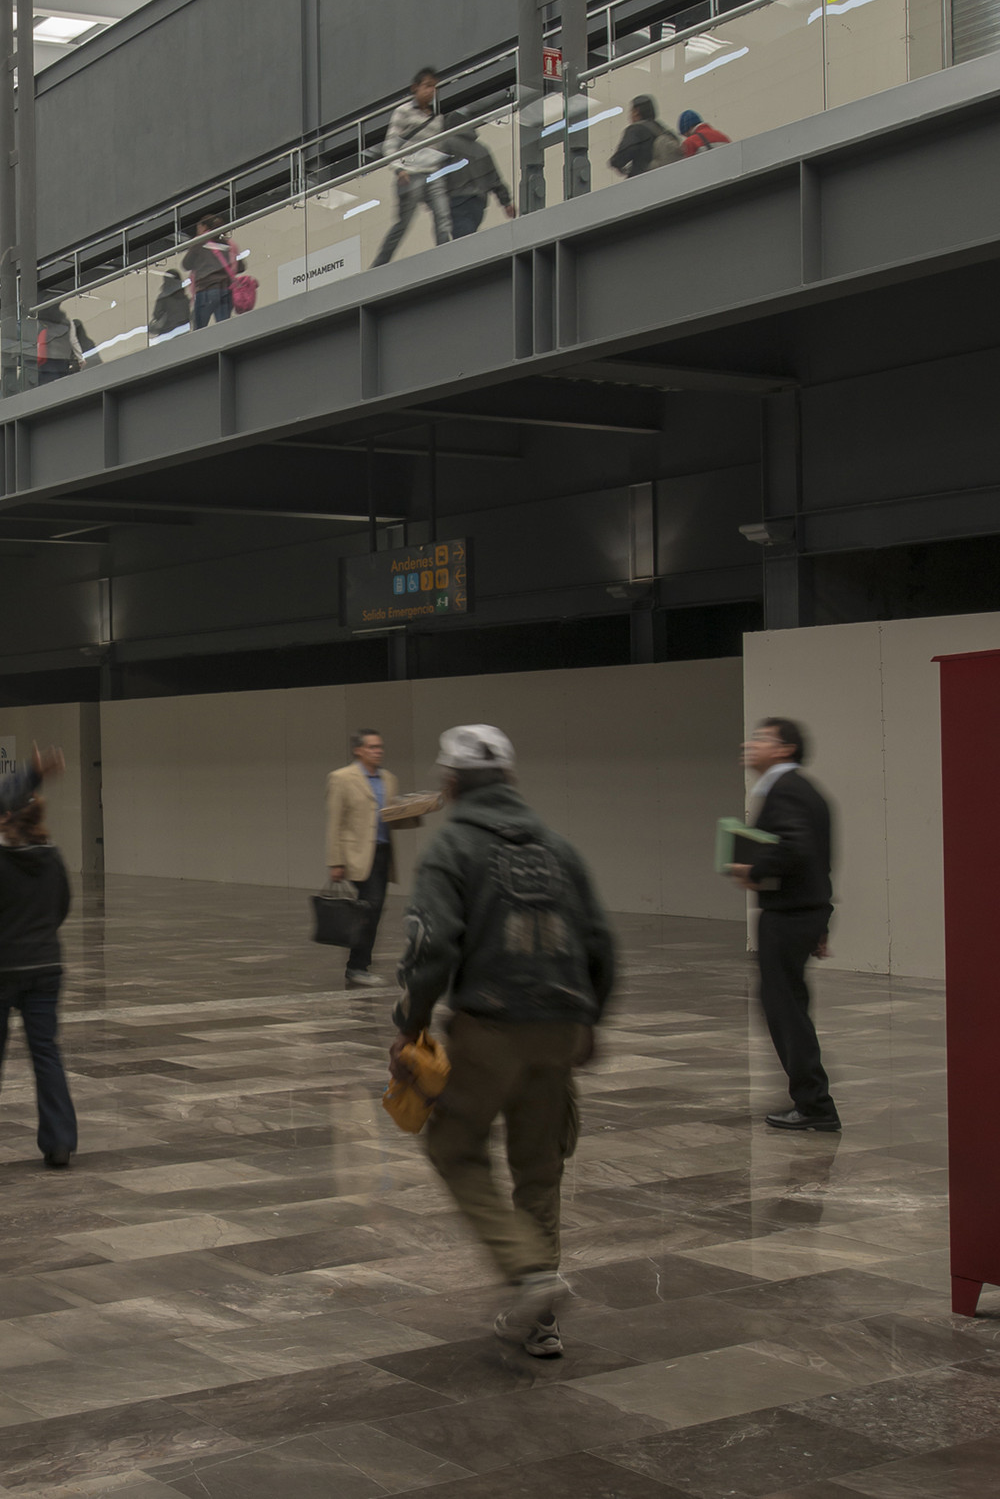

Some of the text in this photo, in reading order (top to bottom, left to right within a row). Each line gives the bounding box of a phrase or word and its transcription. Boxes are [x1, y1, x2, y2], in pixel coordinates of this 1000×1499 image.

[390, 556, 434, 573] Andenes
[362, 605, 434, 621] Salida Emergencia
